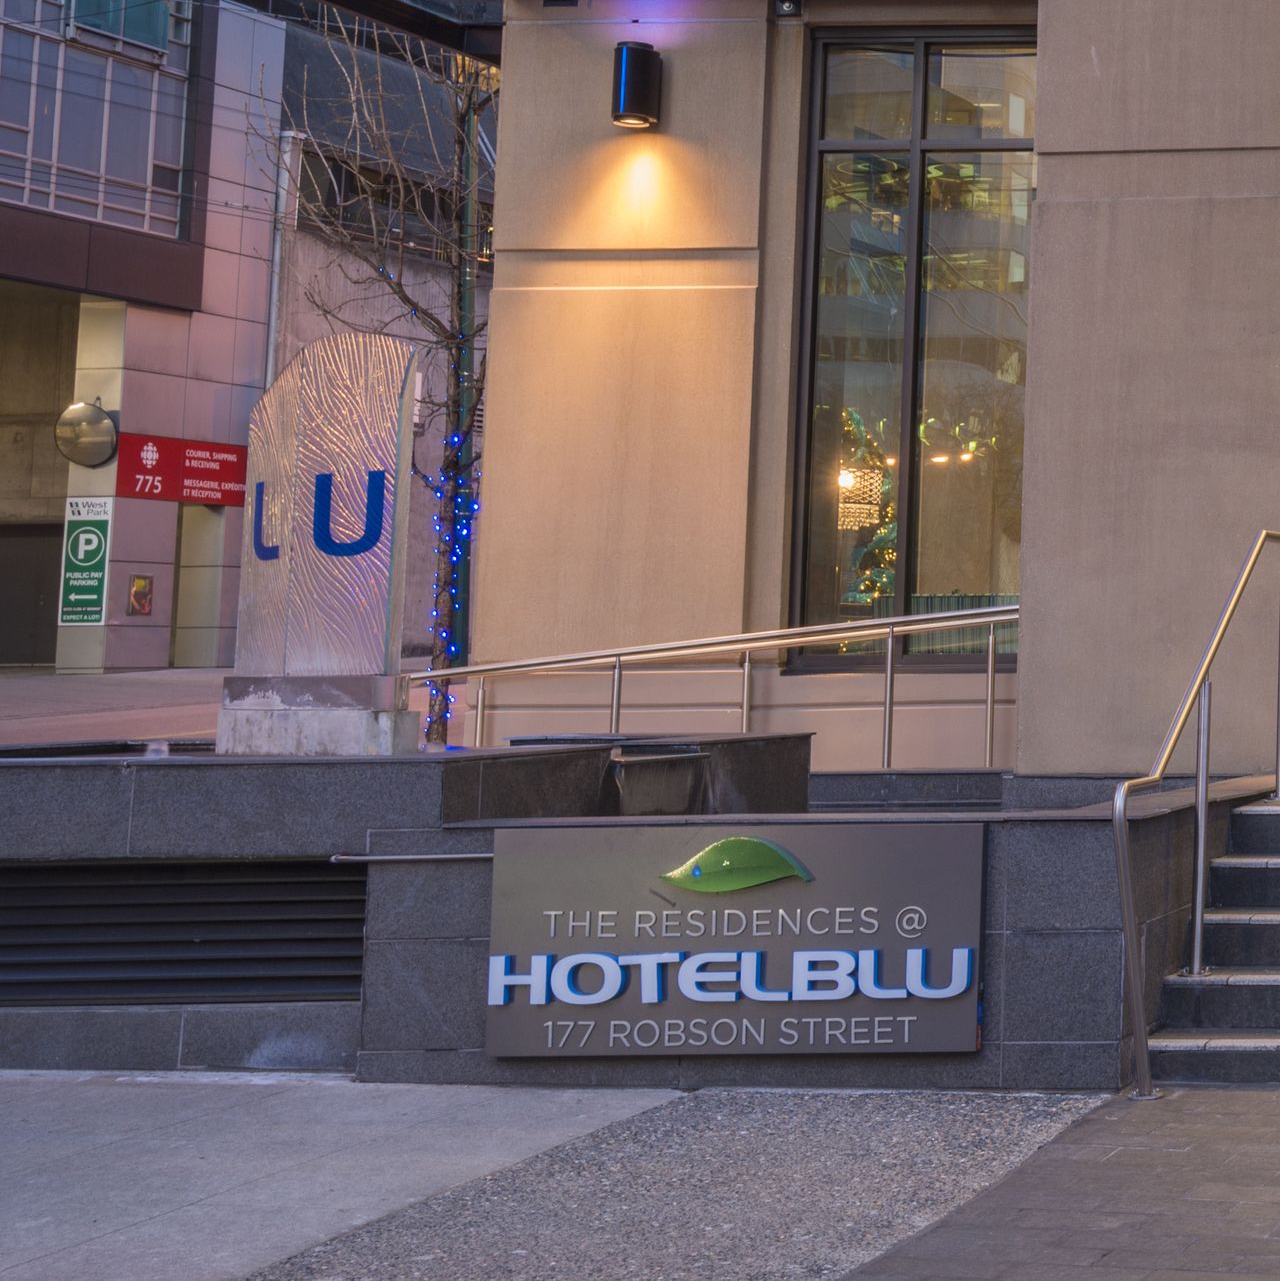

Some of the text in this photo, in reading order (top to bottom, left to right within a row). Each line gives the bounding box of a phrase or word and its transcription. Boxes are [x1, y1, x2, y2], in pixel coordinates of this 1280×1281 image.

[185, 449, 238, 462] COURIER, SHIPPING
[185, 459, 220, 470] & RECEIVING
[135, 474, 162, 494] 775
[183, 478, 220, 490] MESSAGERIE,
[183, 488, 222, 499] ET RÉCEPTION
[81, 501, 108, 509] West
[86, 508, 110, 516] Park
[78, 533, 99, 559] P
[66, 571, 103, 579] PUBLIC PAY
[543, 905, 928, 939] THE RESIDENCES @
[487, 947, 974, 1007] HOTELBLU
[543, 1016, 918, 1049] 177 ROBSON STREET
